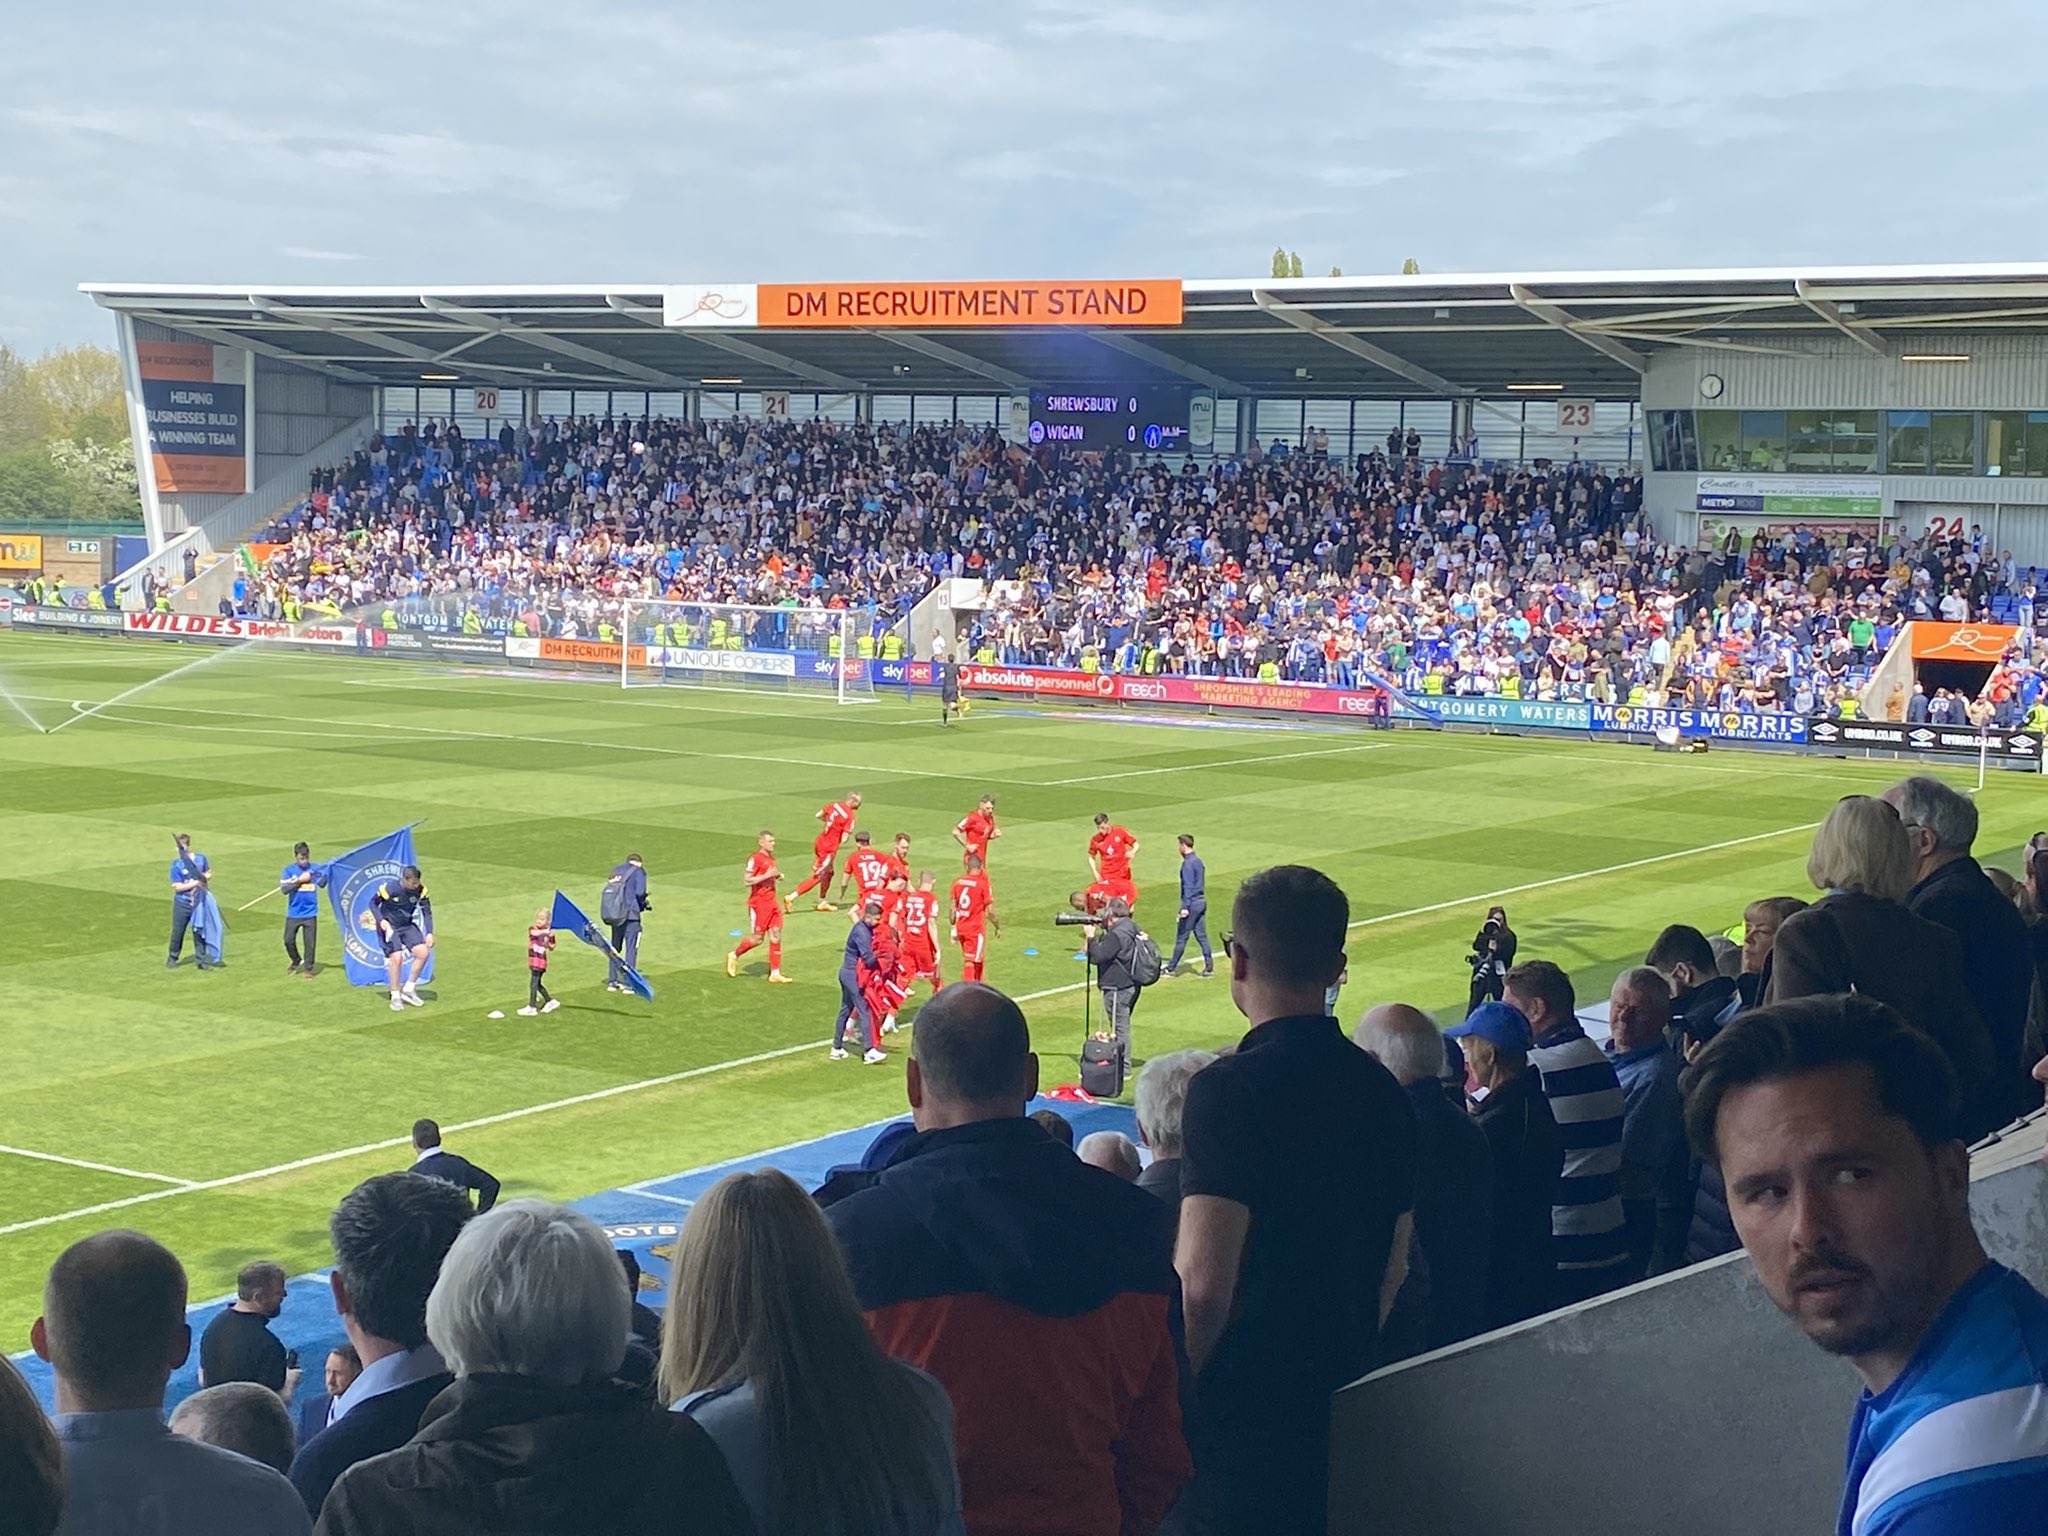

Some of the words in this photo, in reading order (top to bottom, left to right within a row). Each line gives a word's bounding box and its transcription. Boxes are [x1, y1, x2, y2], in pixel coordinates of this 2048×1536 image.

[787, 292, 826, 316] DM
[838, 290, 1039, 316] RECRUITMENT
[1048, 288, 1147, 315] STAND
[170, 391, 213, 405] HELPING
[477, 391, 496, 409] 20
[766, 396, 785, 415] 21
[1047, 397, 1118, 412] SHREWSBURY
[208, 414, 238, 426] BUILD
[1561, 405, 1590, 426] 23
[159, 431, 206, 445] WINNING
[207, 432, 236, 445] TEAM
[1047, 425, 1084, 440] WIGAN
[1931, 517, 1963, 540] 24
[39, 610, 78, 622] BUILDING
[129, 612, 242, 635] WILDES
[545, 643, 562, 656] DM
[673, 651, 731, 667] UNIQUE
[814, 659, 836, 675] sky
[882, 664, 904, 680] sky
[974, 668, 1034, 687] absolute
[1035, 676, 1096, 691] personnel
[1262, 696, 1303, 707] AGENCY
[1267, 688, 1311, 699] LEADING
[1520, 705, 1588, 721] WATERS
[1711, 727, 1792, 741] LUBRICANTS
[858, 861, 881, 881] 19
[959, 887, 971, 909] 6
[906, 903, 926, 926] 23
